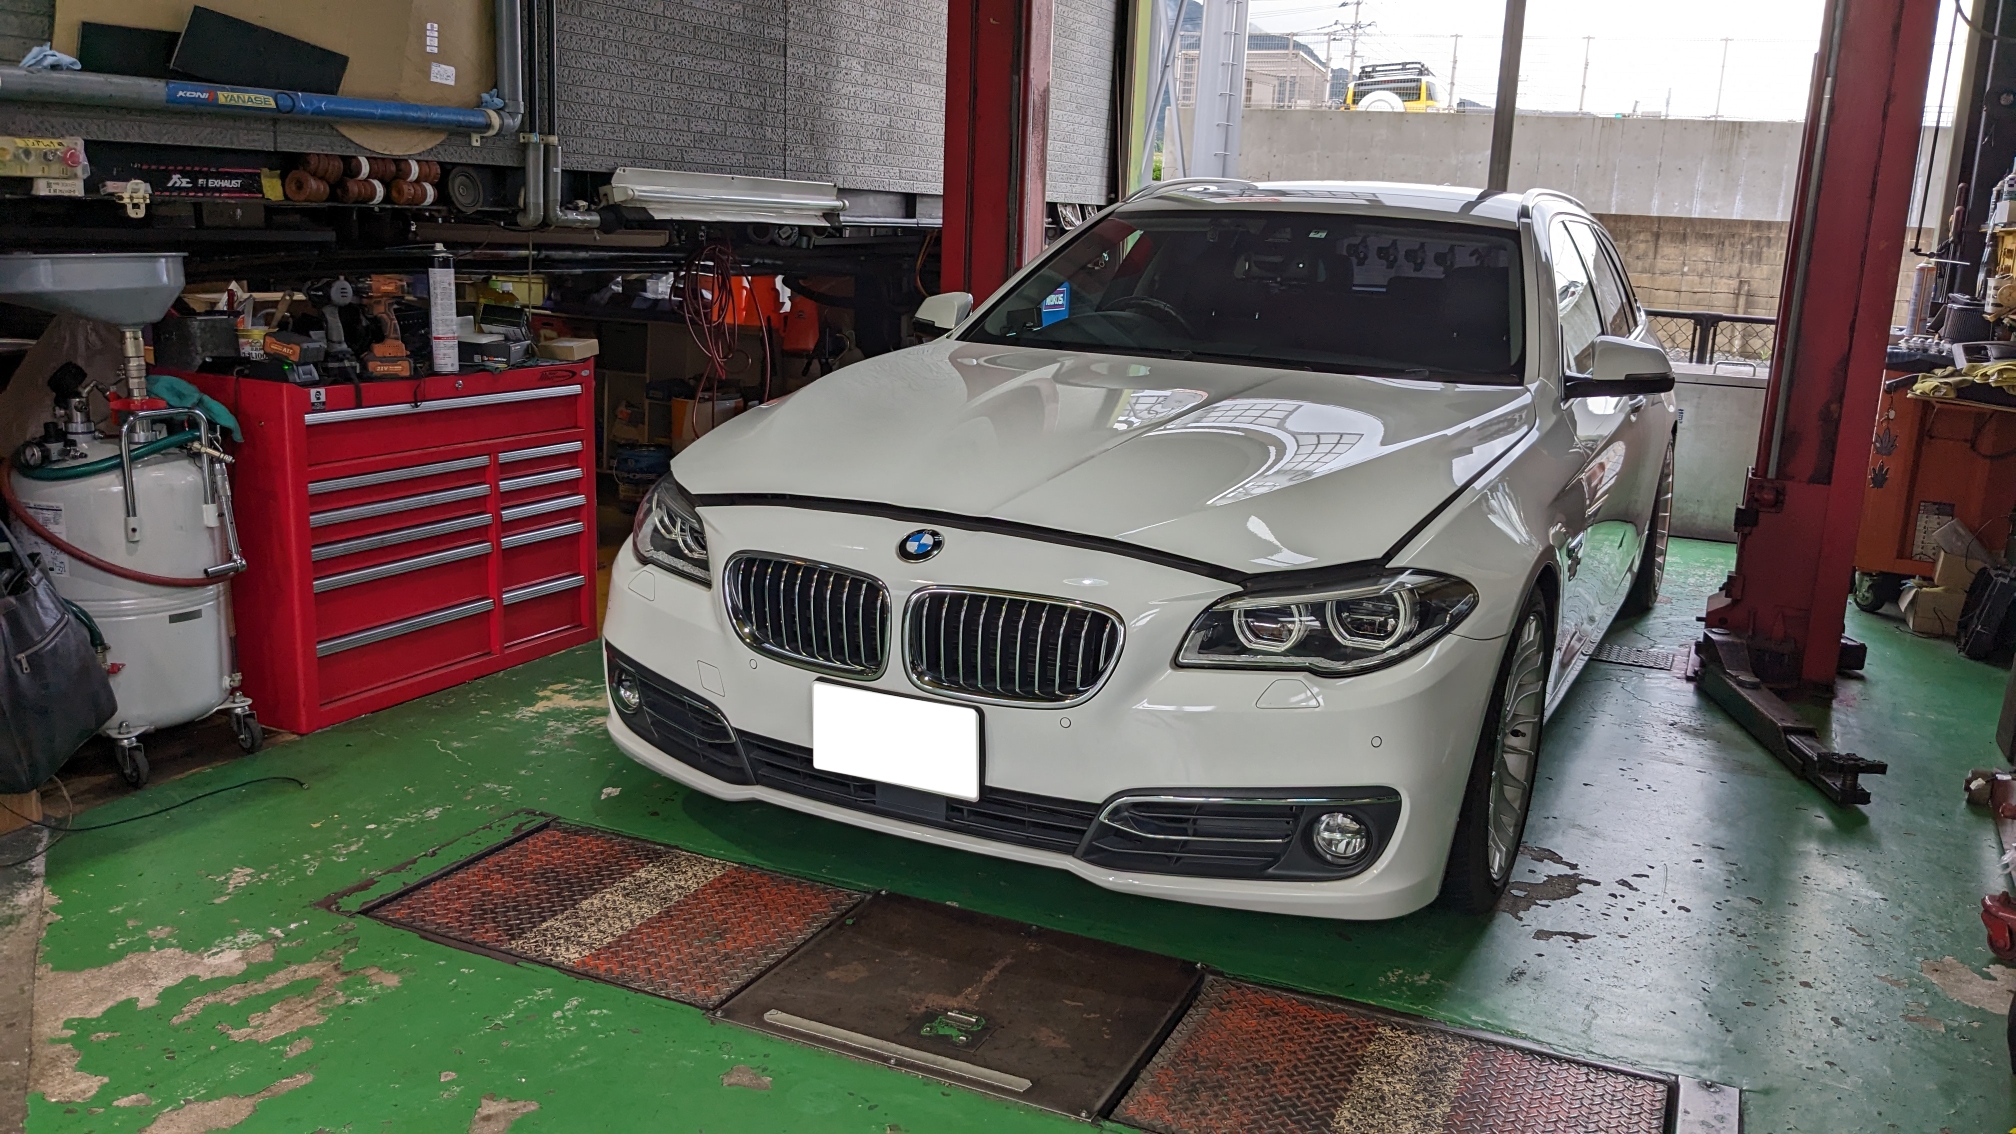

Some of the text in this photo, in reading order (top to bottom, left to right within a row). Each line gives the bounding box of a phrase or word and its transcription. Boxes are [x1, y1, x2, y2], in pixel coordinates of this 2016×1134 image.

[177, 91, 209, 99] KONI
[222, 93, 272, 106] YANASE
[208, 179, 242, 188] EXHAUST
